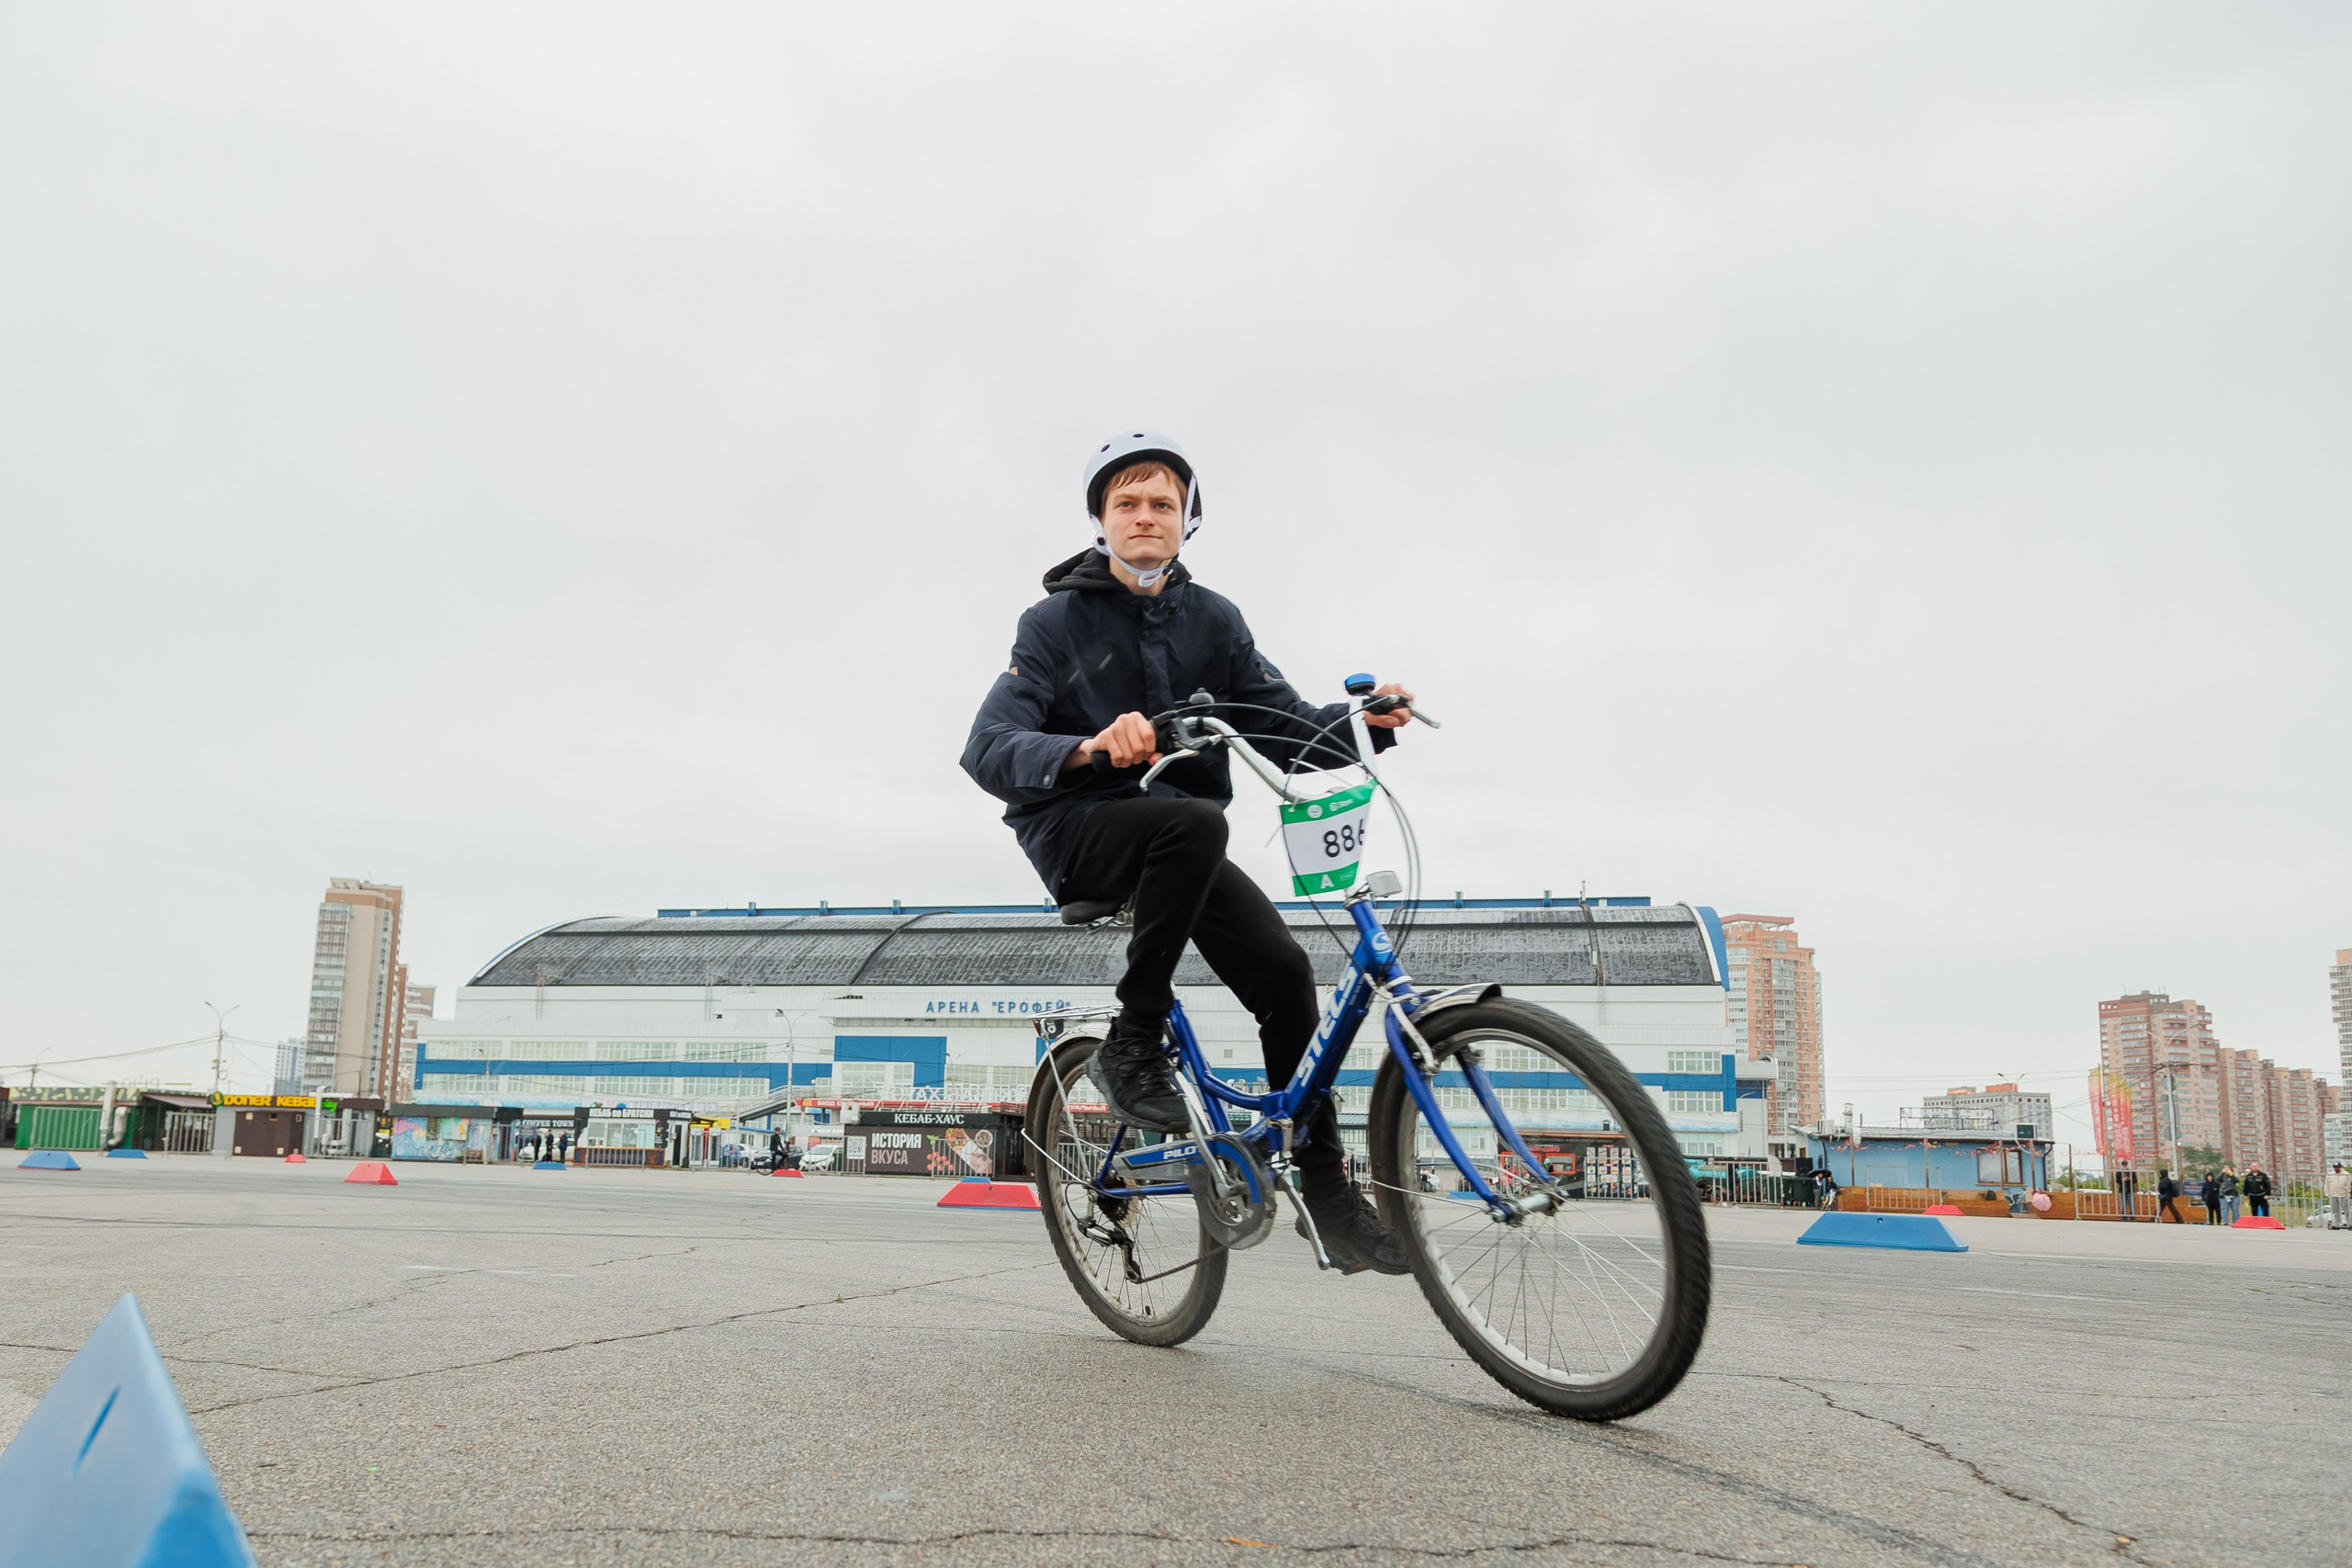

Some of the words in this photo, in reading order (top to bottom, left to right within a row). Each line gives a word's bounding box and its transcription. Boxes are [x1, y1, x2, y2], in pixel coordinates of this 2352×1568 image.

[1320, 874, 1335, 889] A
[926, 1001, 979, 1013] АРЕНА
[992, 999, 1070, 1014] "ЕРОФЕЙ"
[1295, 965, 1359, 1088] STELS
[552, 1119, 574, 1128] TOWN
[894, 1113, 965, 1124] КЕБАБ-ХАУС
[871, 1133, 922, 1149] ИСТОРИЯ
[871, 1149, 909, 1166] ВКУСА
[1163, 1145, 1202, 1159] PILO
